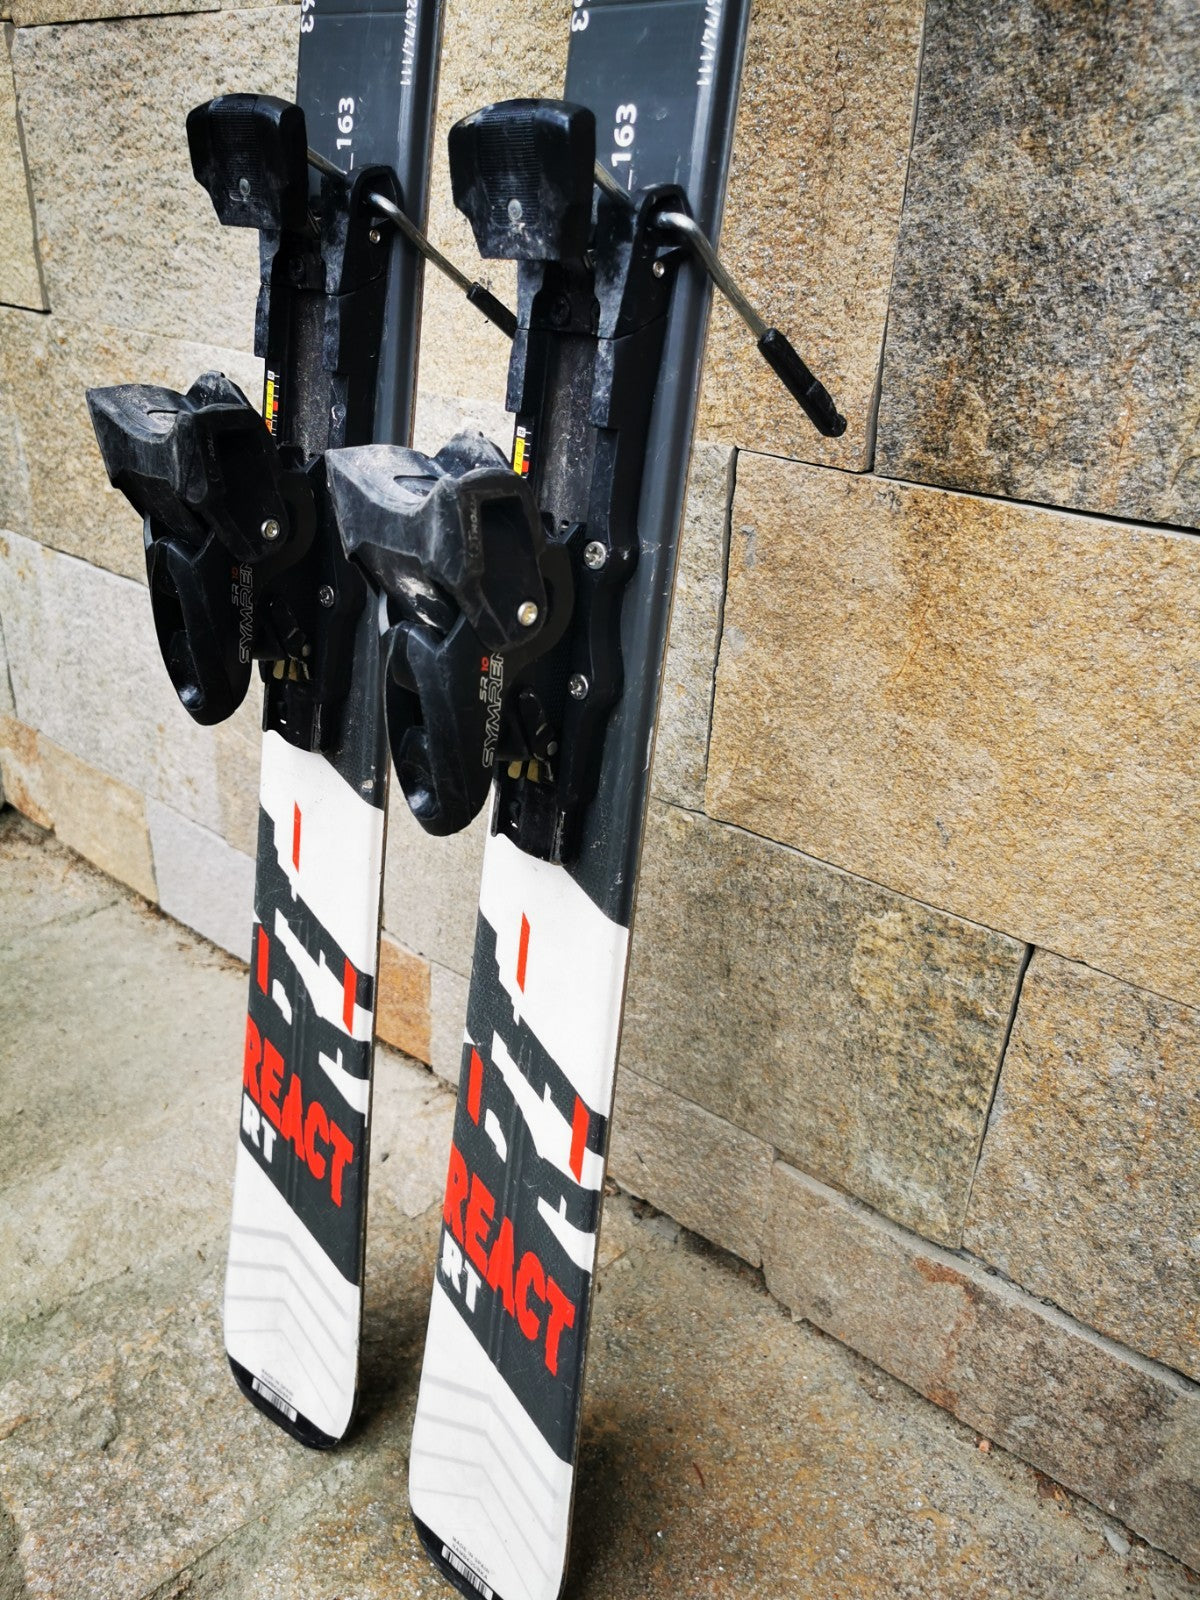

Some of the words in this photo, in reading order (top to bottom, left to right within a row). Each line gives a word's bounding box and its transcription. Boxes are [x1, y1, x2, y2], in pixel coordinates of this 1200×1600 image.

[336, 97, 355, 150] 163
[611, 103, 638, 168] 163
[231, 583, 239, 606] SR
[479, 676, 488, 703] SR
[481, 657, 490, 672] 10
[242, 1092, 277, 1164] RT
[243, 1013, 354, 1208] REACT
[441, 1228, 482, 1314] RT
[443, 1140, 576, 1376] REACT
